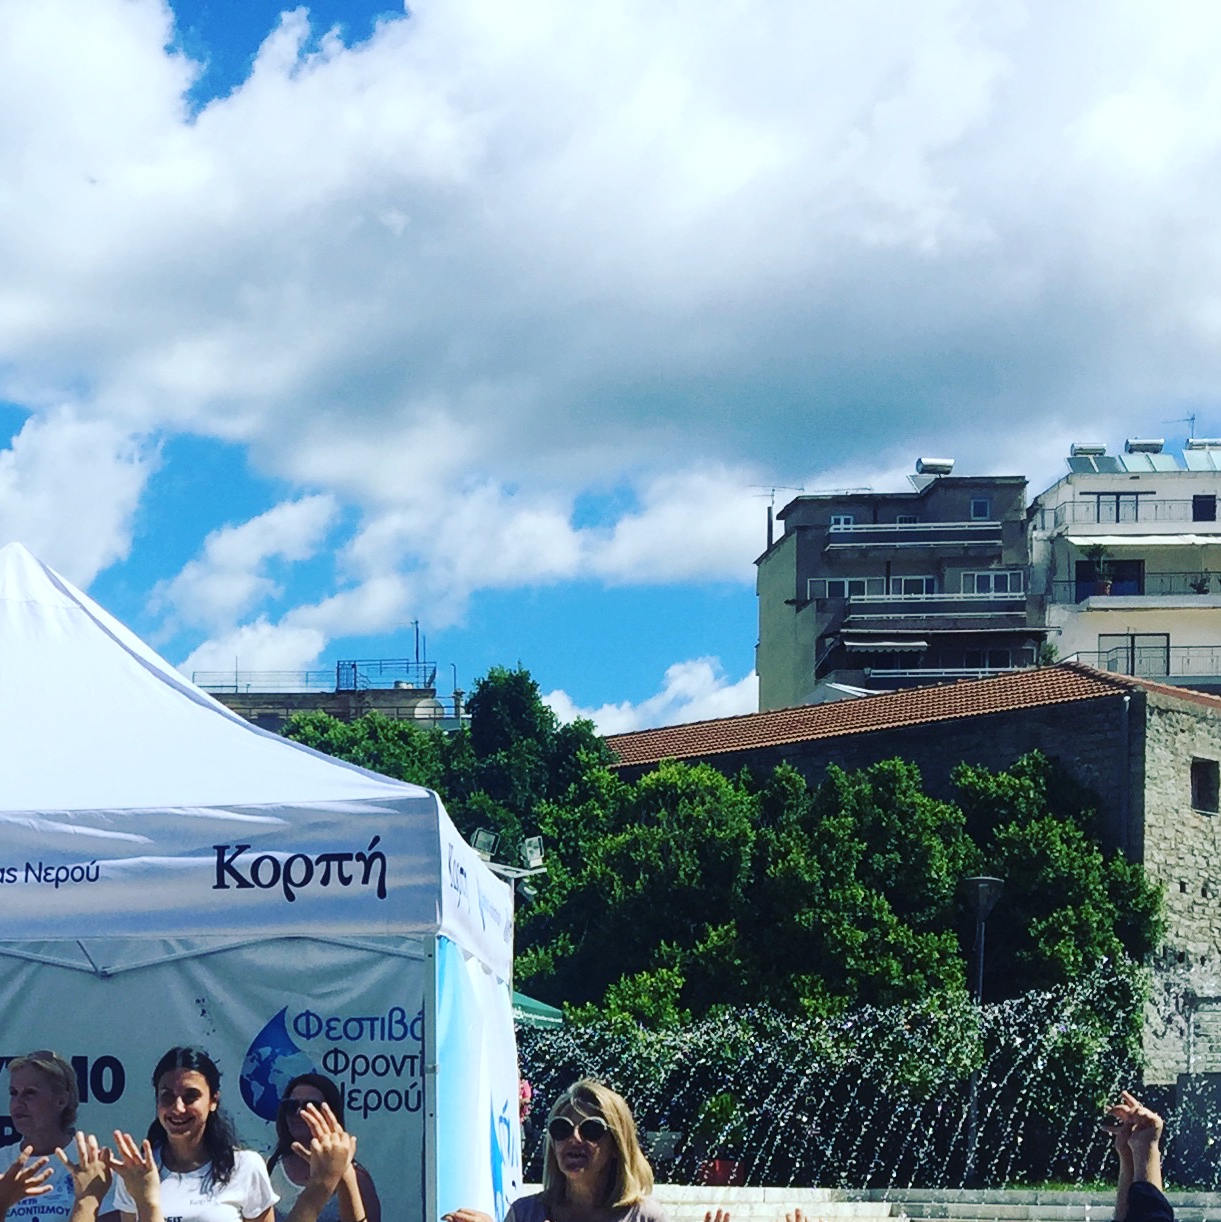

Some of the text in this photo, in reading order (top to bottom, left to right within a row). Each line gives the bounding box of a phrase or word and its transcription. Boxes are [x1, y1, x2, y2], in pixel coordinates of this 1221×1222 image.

[24, 860, 100, 889] Νερού
[212, 835, 387, 902] Κορπή
[340, 1083, 422, 1119] ερού
